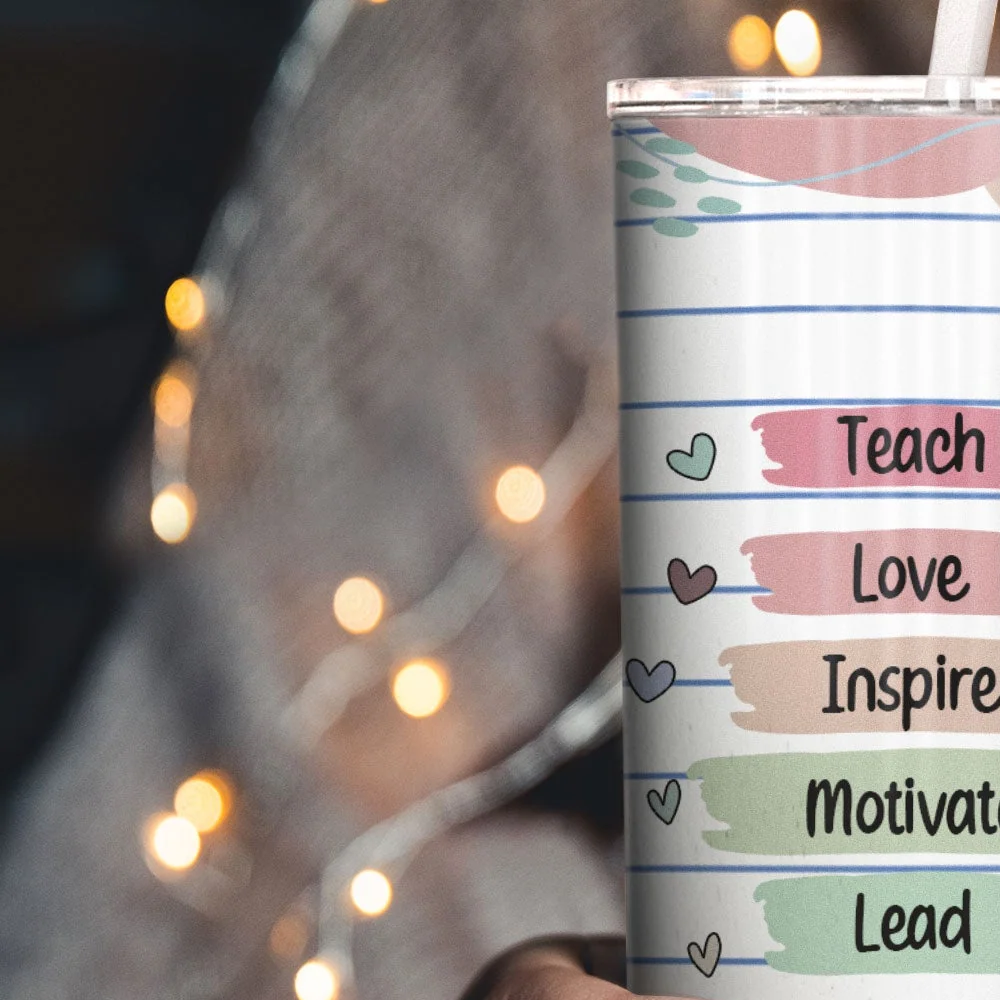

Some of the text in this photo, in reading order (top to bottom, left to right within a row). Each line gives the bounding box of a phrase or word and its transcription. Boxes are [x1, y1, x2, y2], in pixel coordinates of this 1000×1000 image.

[836, 412, 986, 476] Teach
[852, 542, 971, 603] Love
[854, 888, 971, 955] Lead
